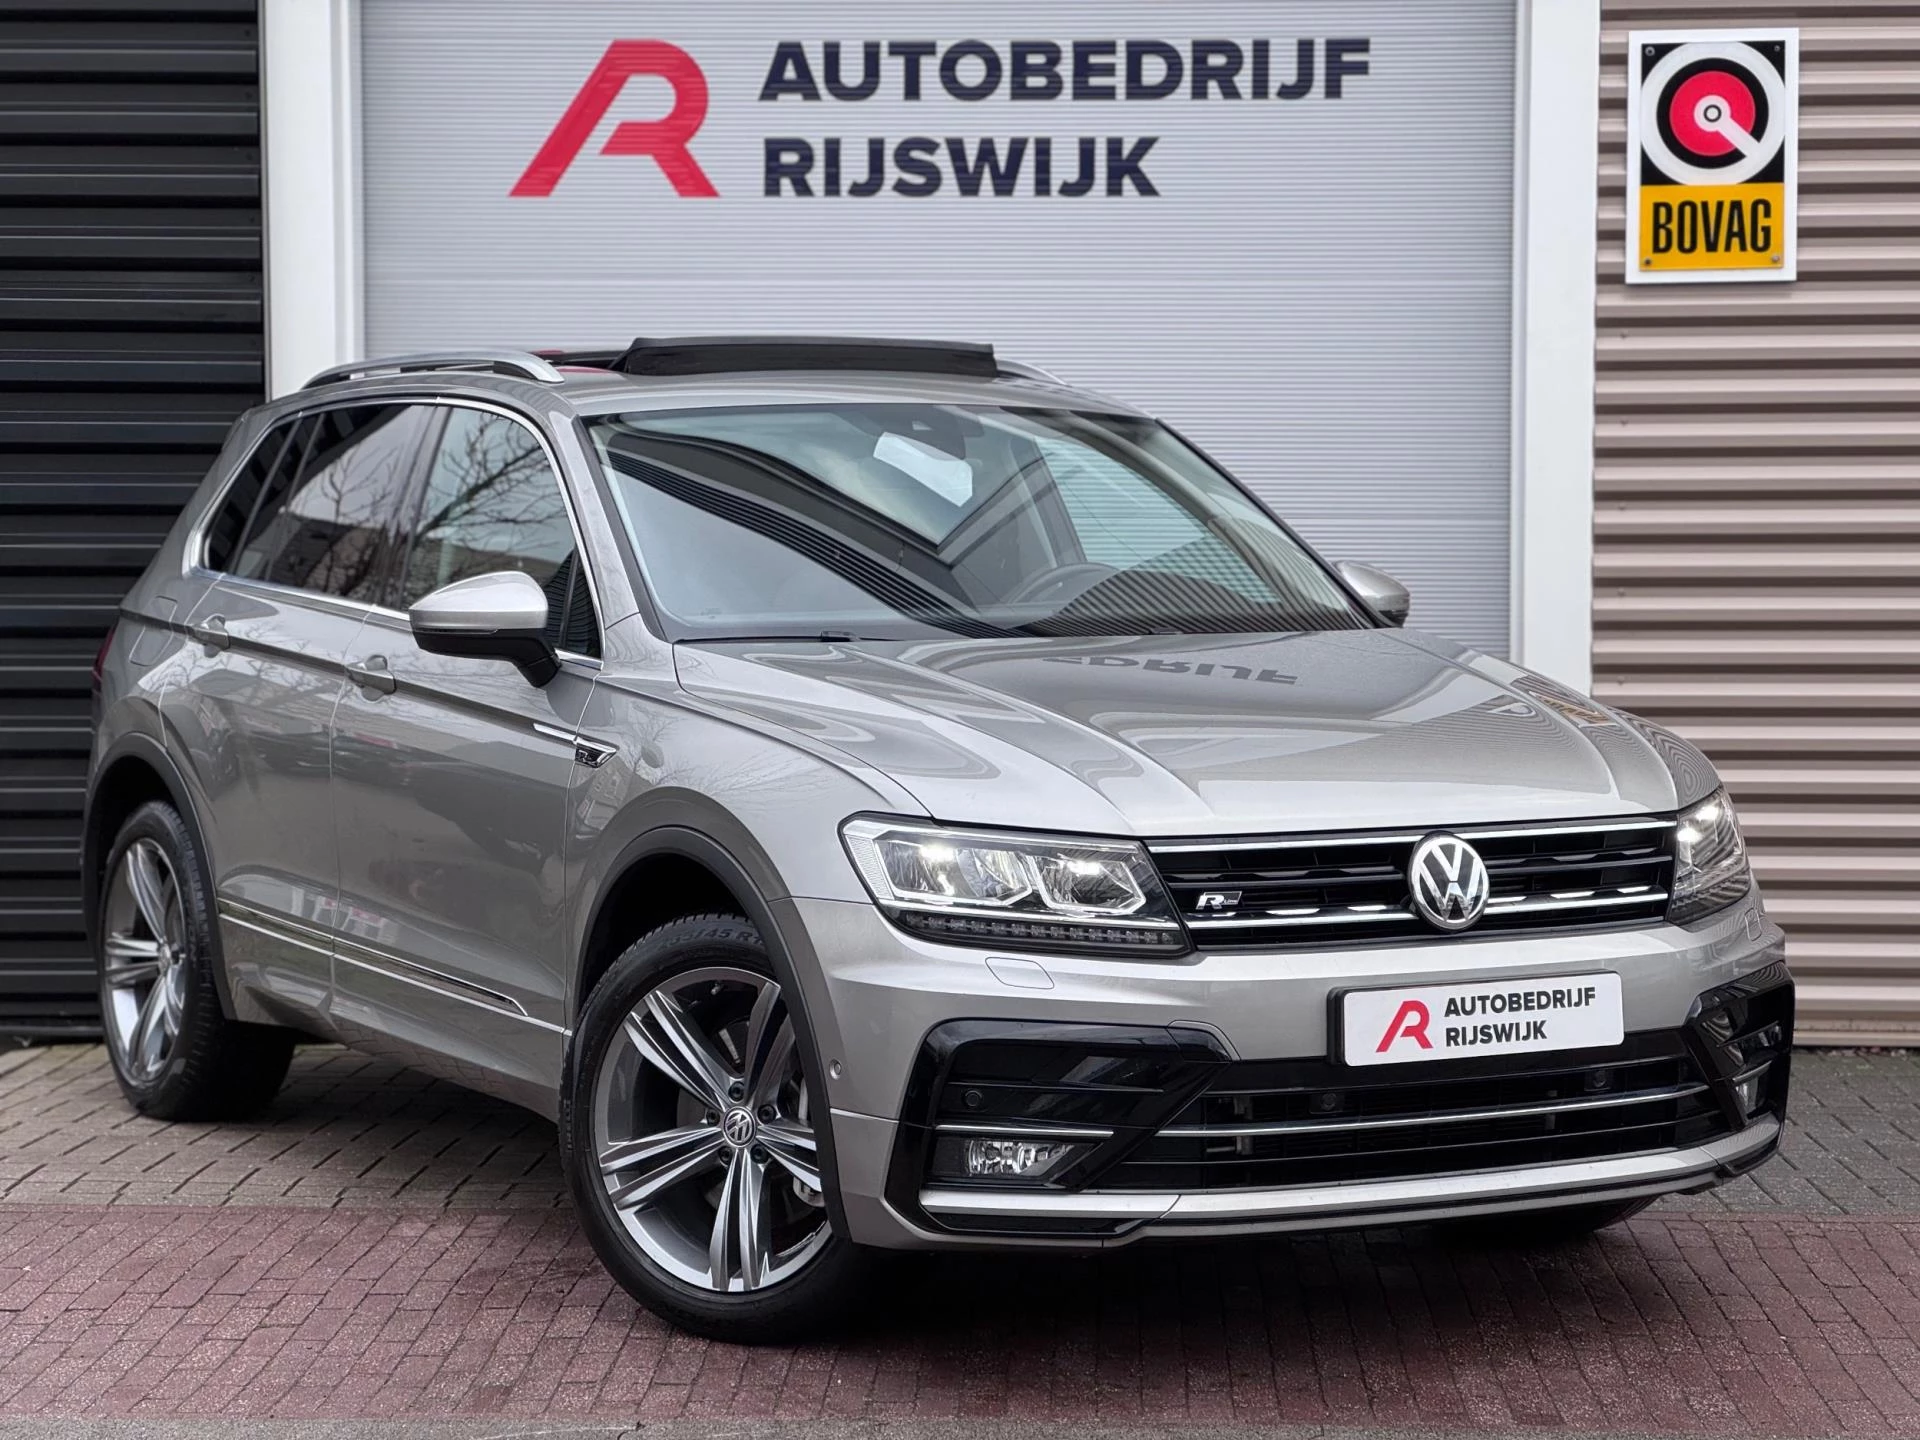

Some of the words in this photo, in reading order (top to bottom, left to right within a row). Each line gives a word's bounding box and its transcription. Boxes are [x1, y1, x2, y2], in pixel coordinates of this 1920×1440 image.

[758, 38, 1370, 101] AUTOBEDRIJF
[763, 137, 1161, 197] RIJSWIJK
[1652, 198, 1772, 255] BOVAG
[1444, 986, 1596, 1018] AUTOBEDRIJF
[1446, 1020, 1548, 1047] RIJSWIJK
